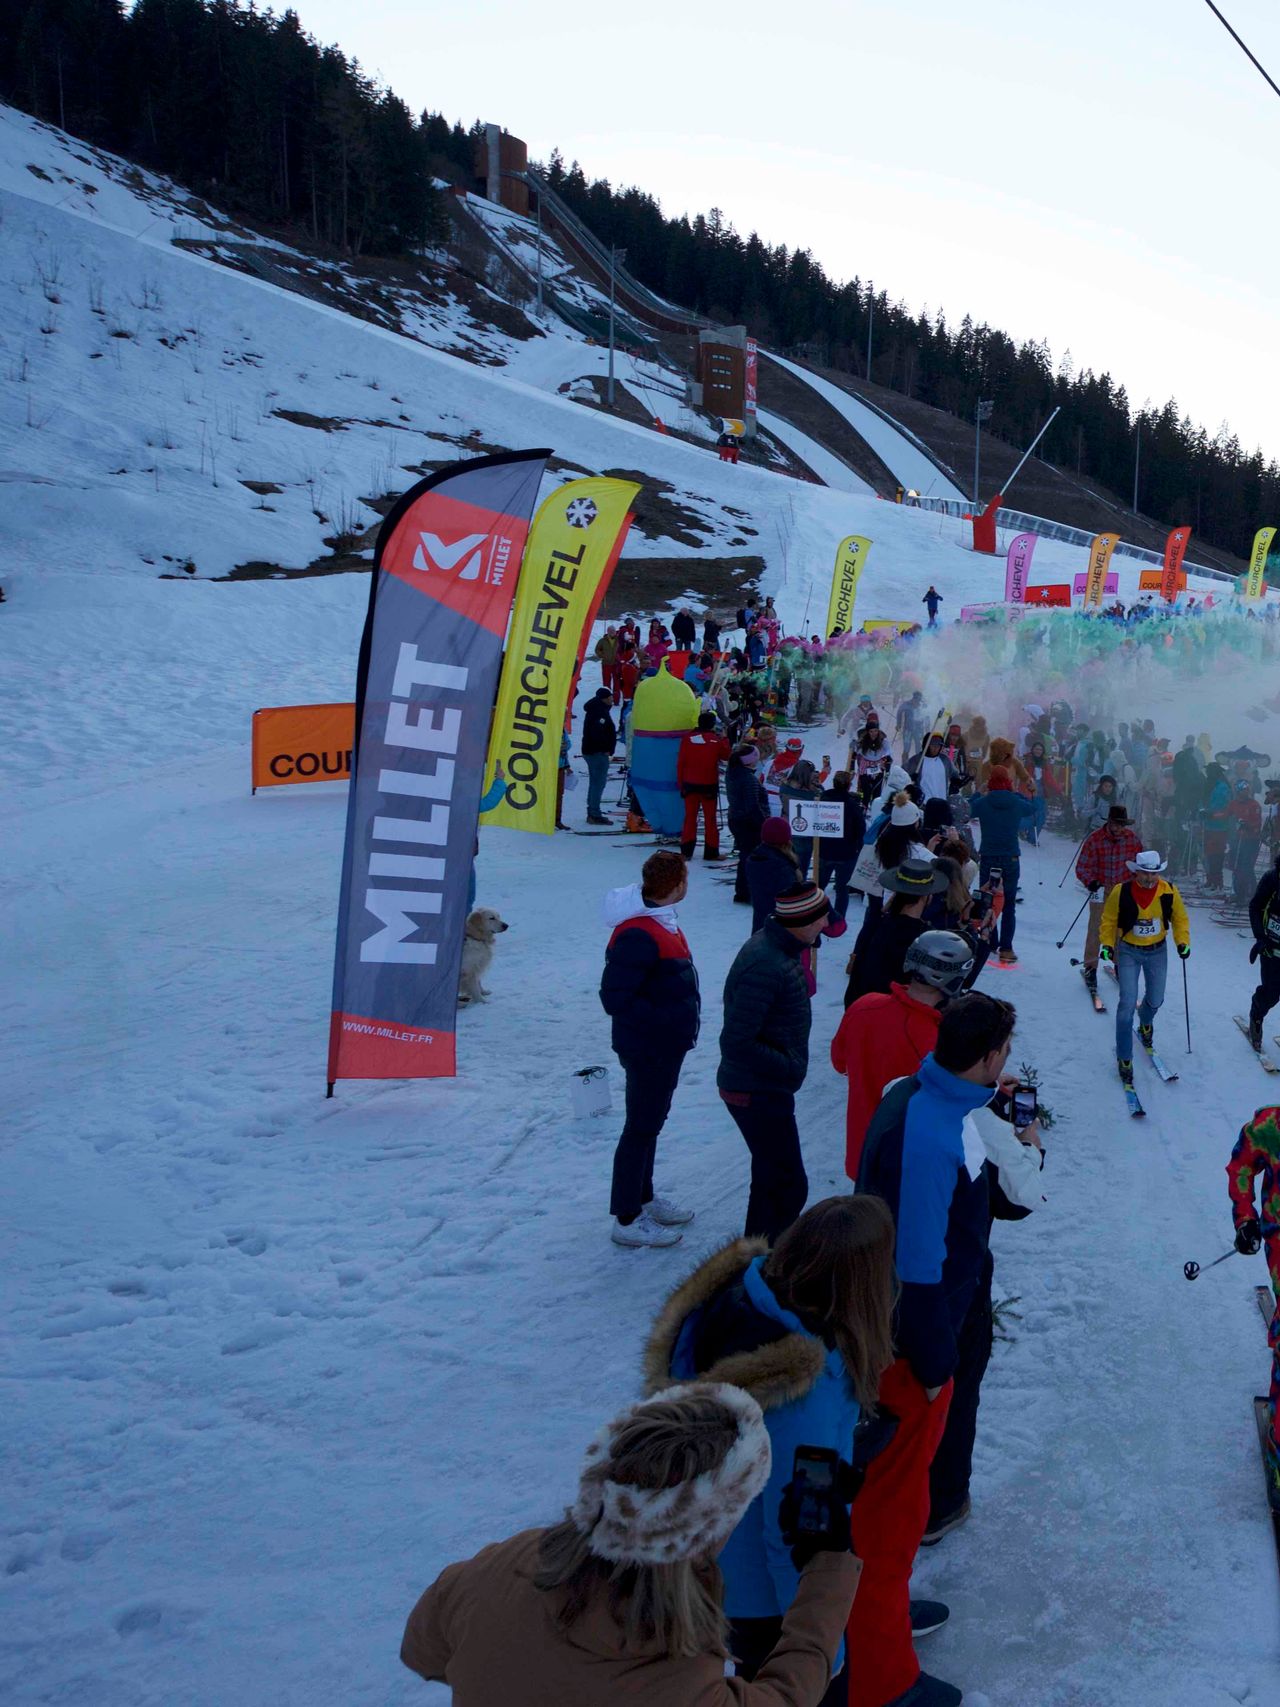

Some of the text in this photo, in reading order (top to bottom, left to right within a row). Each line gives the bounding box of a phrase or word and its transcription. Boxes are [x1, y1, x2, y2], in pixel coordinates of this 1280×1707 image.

[492, 536, 513, 586] MILLET
[1249, 541, 1268, 597] COURCHEVEL
[505, 543, 587, 811] COURCHEVEL
[360, 642, 469, 964] MILLET
[1139, 926, 1156, 935] 234
[343, 1021, 433, 1044] WWW.MILLET.FR
